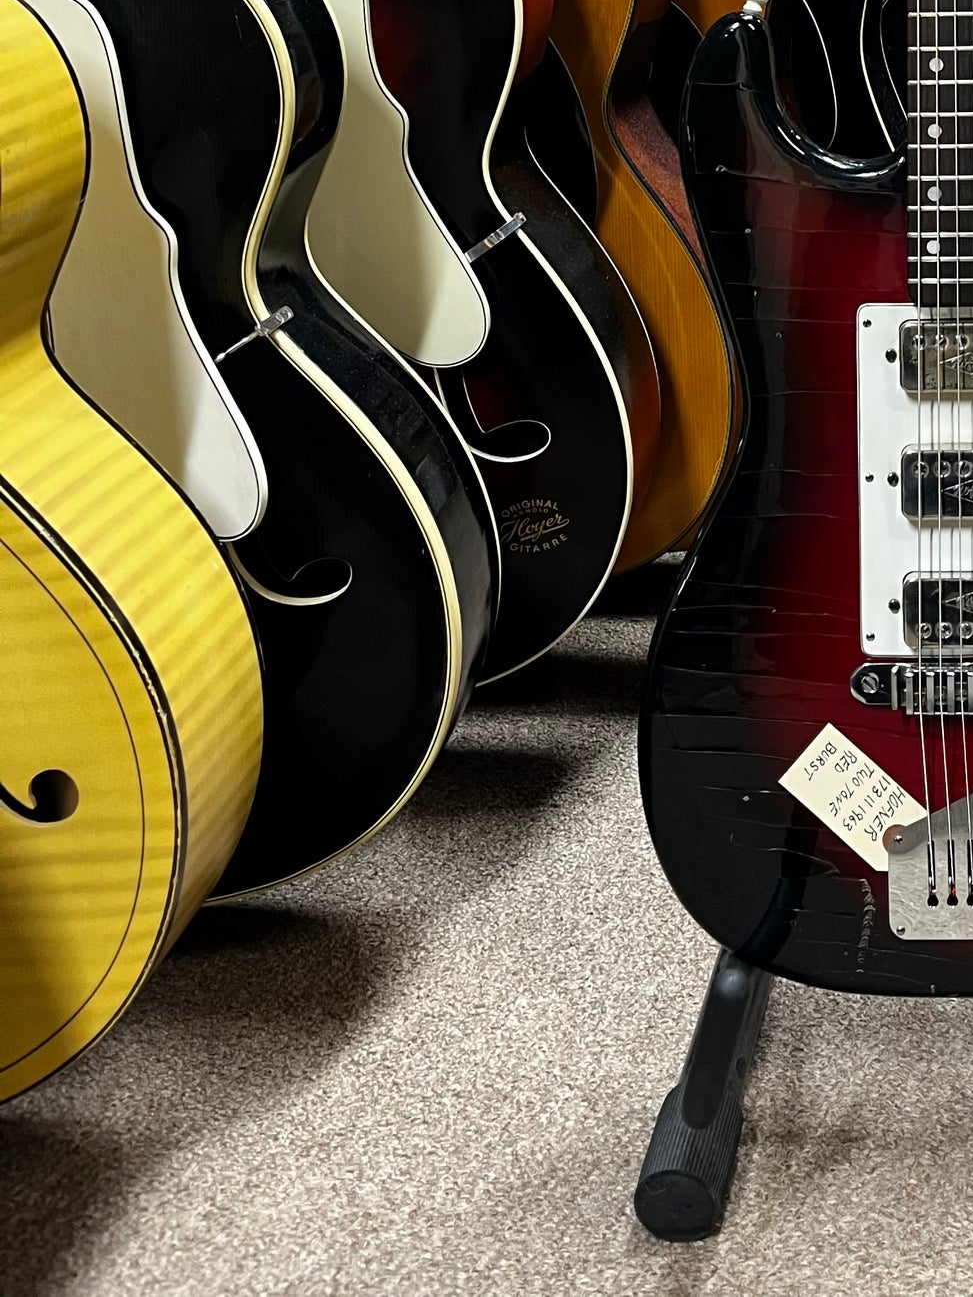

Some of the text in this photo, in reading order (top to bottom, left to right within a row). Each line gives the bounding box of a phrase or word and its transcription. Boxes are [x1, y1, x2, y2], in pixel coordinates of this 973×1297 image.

[501, 499, 559, 518] ORIGINAL
[500, 513, 570, 543] Hoyer
[510, 533, 568, 553] GITARRE
[803, 740, 838, 782] BURST
[834, 750, 858, 773] RED
[828, 762, 875, 817] TWO TONE
[871, 775, 892, 798] 173
[842, 804, 867, 832] 1963
[863, 786, 907, 842] HOFNER
